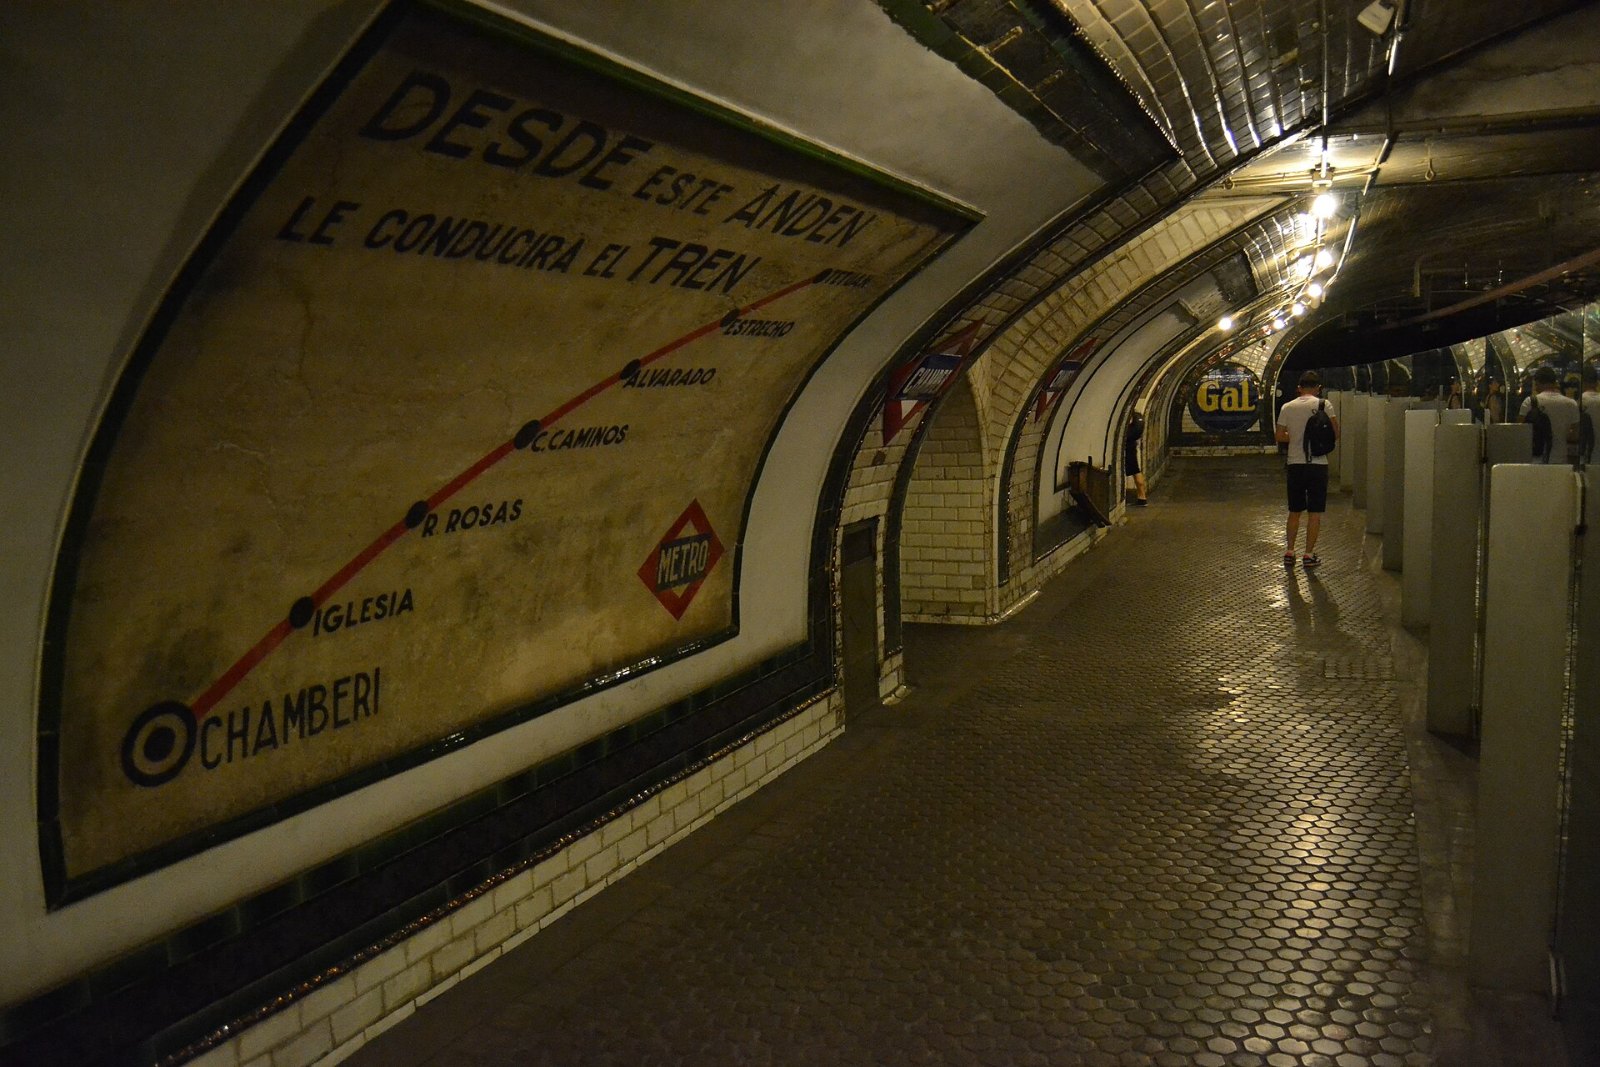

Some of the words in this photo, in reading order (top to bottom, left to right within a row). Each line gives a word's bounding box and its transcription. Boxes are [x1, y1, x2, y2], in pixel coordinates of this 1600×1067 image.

[359, 69, 653, 191] DESDE
[632, 165, 735, 217] ESTE
[725, 183, 878, 248] ANDEN
[278, 196, 359, 245] LE
[363, 208, 585, 273] CONDUCIRA
[583, 242, 631, 280] EL
[626, 237, 762, 294] TREN
[723, 318, 795, 337] ESTRECHO
[623, 367, 717, 389] ALVARADO
[1196, 379, 1257, 413] Gal
[444, 499, 523, 533] ROSAS
[657, 539, 710, 585] METRO
[312, 588, 414, 637] IGLESIA
[201, 666, 381, 770] CHAMBERI
